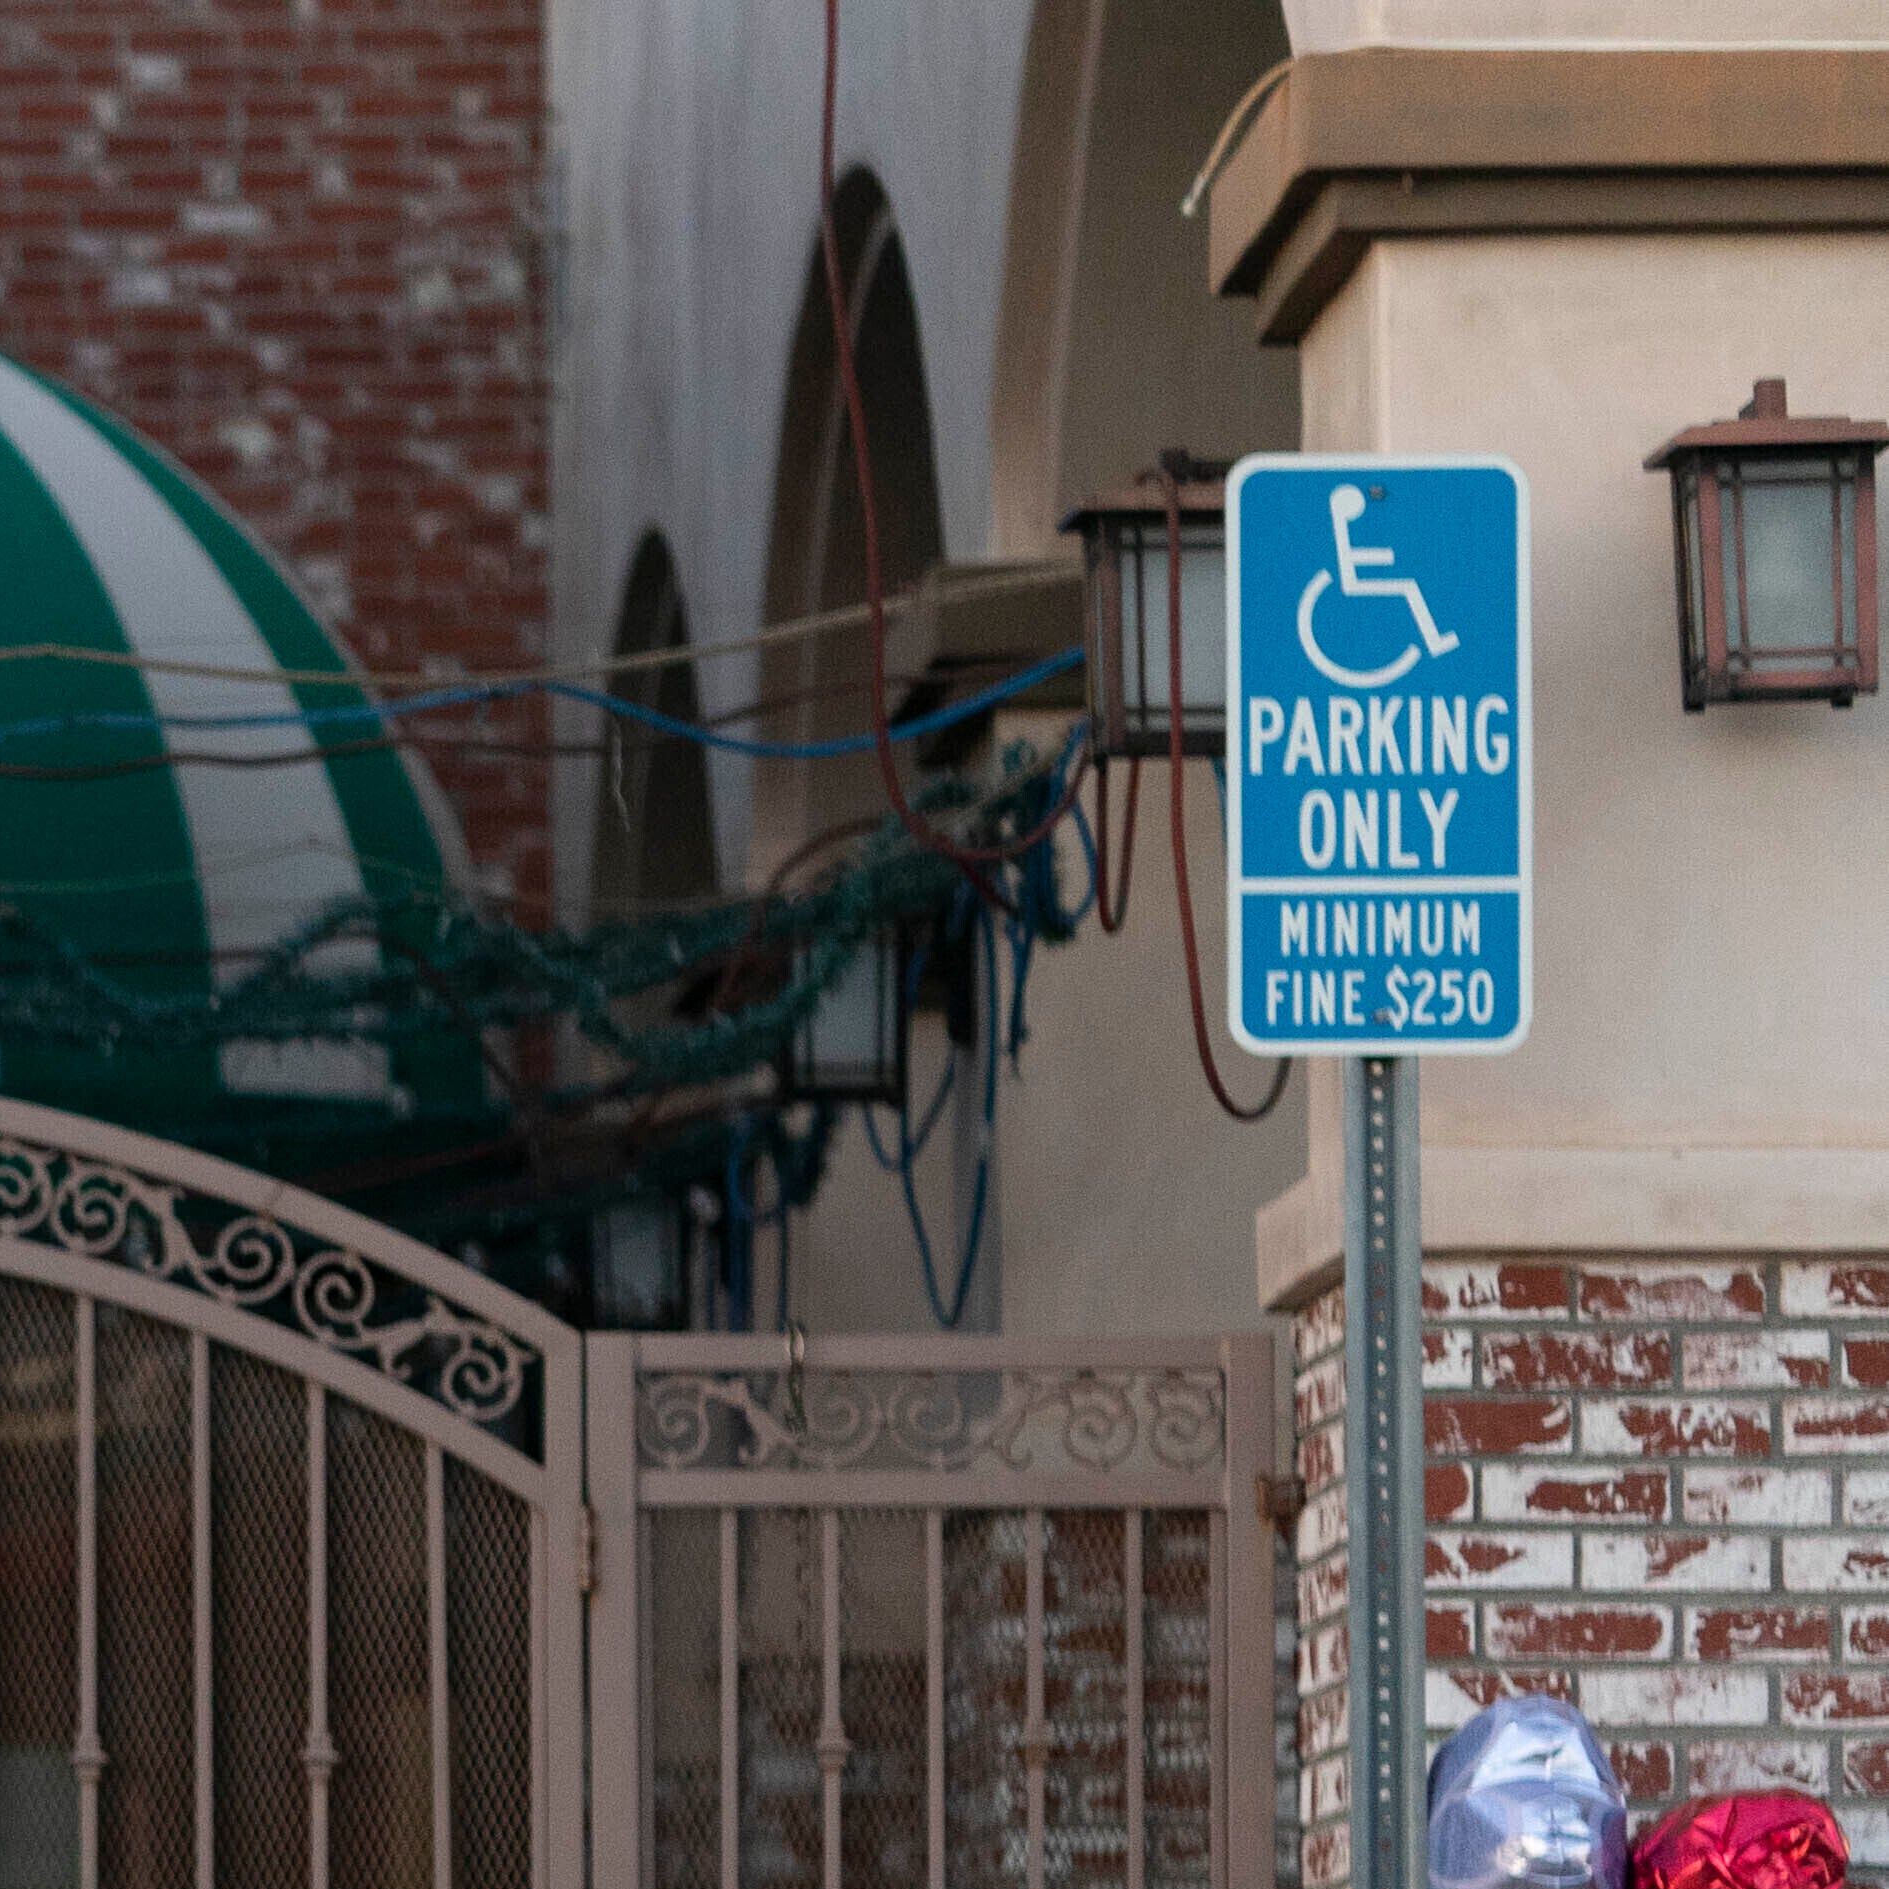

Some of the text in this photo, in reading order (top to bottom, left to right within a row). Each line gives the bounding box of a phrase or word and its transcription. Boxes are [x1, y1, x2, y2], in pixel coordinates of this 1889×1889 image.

[1248, 694, 1510, 776] PARKING
[1298, 788, 1460, 869] ONLY
[1280, 901, 1481, 956] MINIMUM
[1266, 964, 1495, 1032] FINE $250
